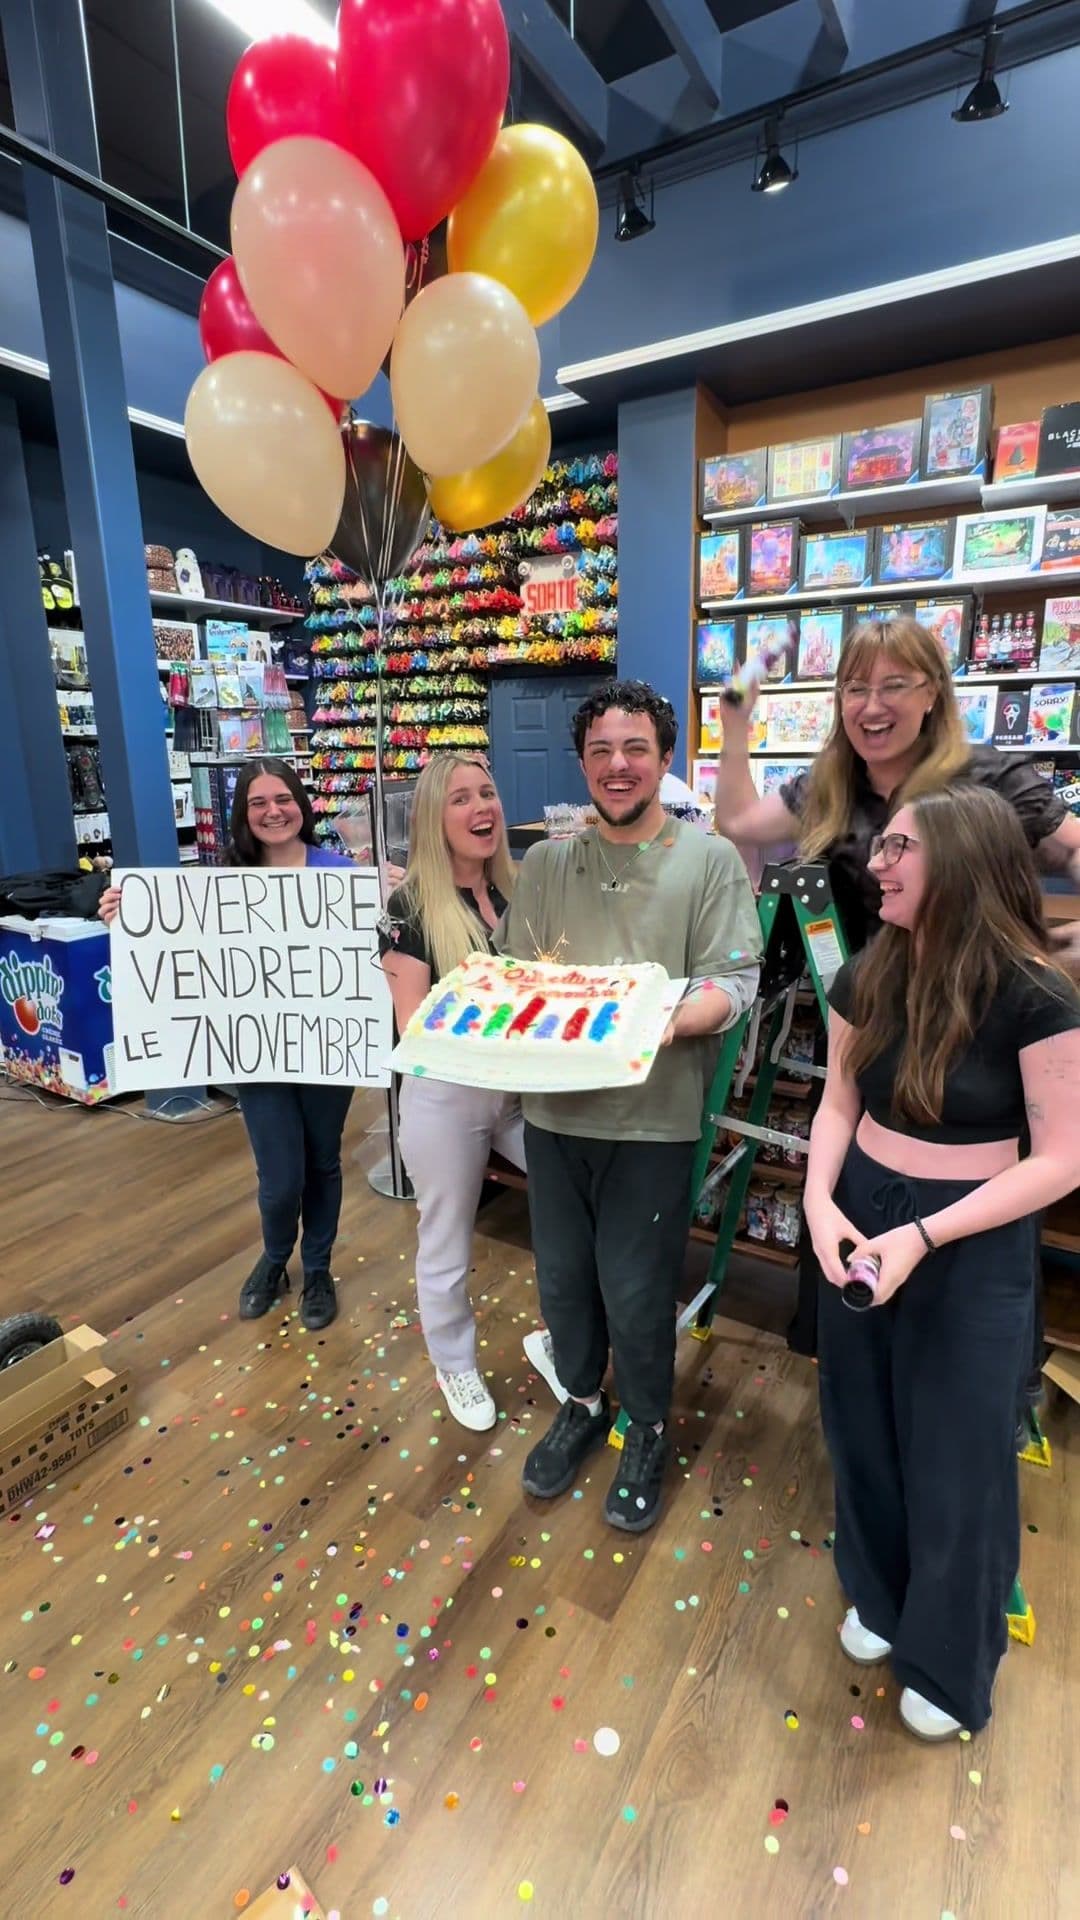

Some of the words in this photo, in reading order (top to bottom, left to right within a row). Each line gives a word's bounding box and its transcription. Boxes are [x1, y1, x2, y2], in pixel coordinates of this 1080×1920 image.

[1048, 428, 1080, 441] BLAC
[526, 577, 577, 613] SORTIE
[1033, 761, 1055, 771] UNO
[119, 872, 378, 938] OUVERTURE
[130, 945, 373, 1004] VENDREDI
[37, 1000, 61, 1025] dots
[123, 1031, 162, 1062] LE
[69, 1419, 95, 1441] TOYS
